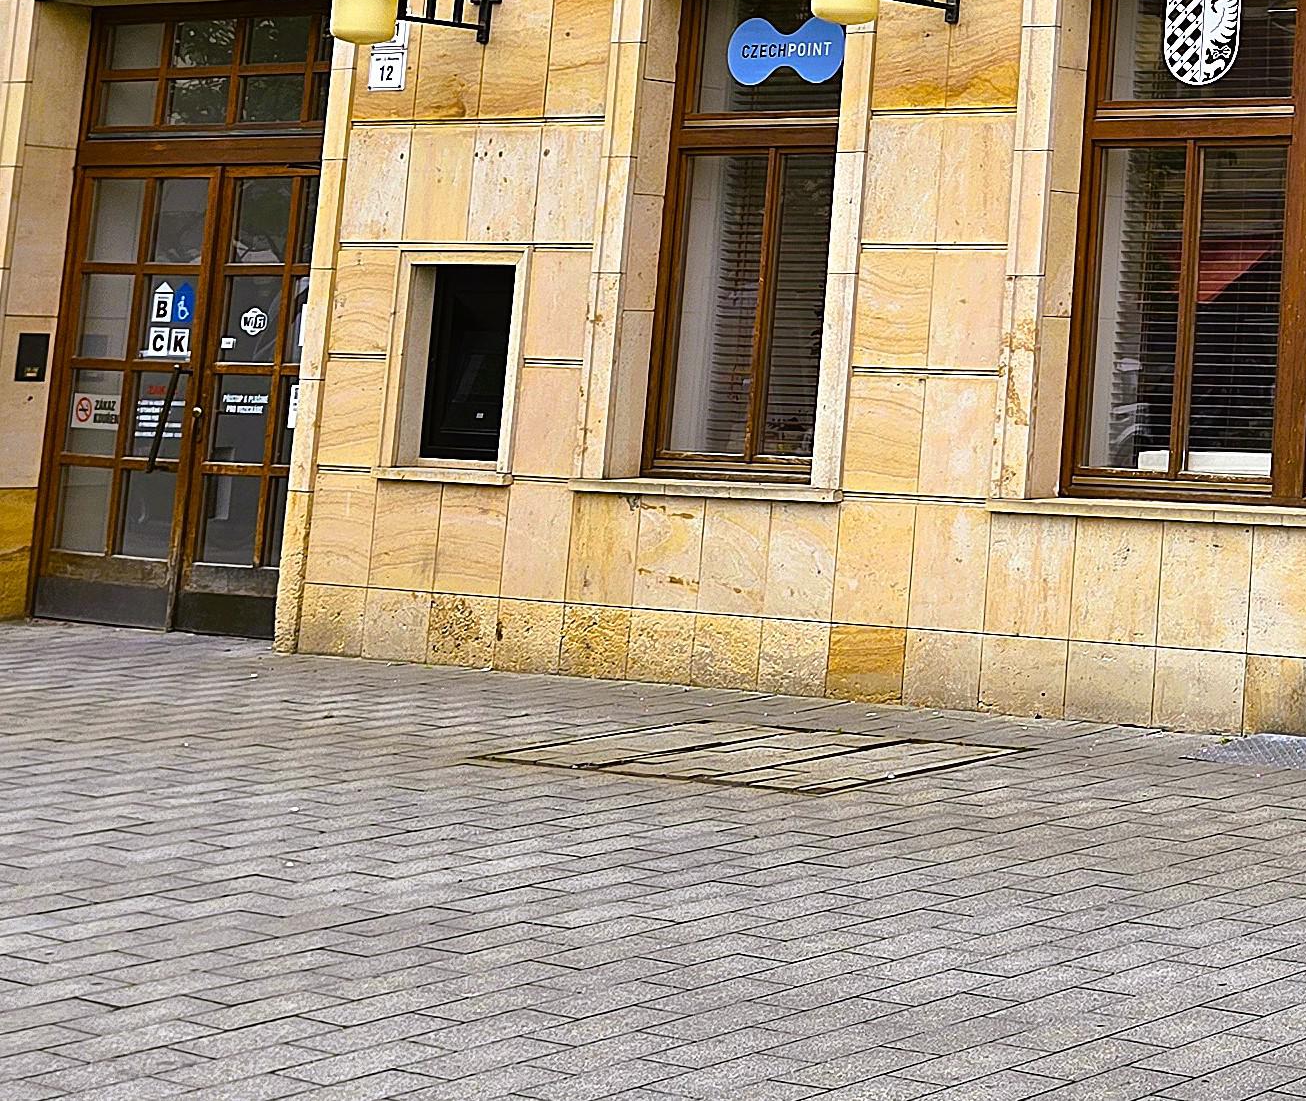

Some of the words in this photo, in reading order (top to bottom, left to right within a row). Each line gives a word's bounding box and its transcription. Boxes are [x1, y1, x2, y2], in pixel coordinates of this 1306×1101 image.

[380, 65, 394, 82] 12
[156, 300, 168, 318] B
[152, 334, 164, 352] C
[173, 335, 184, 352] K
